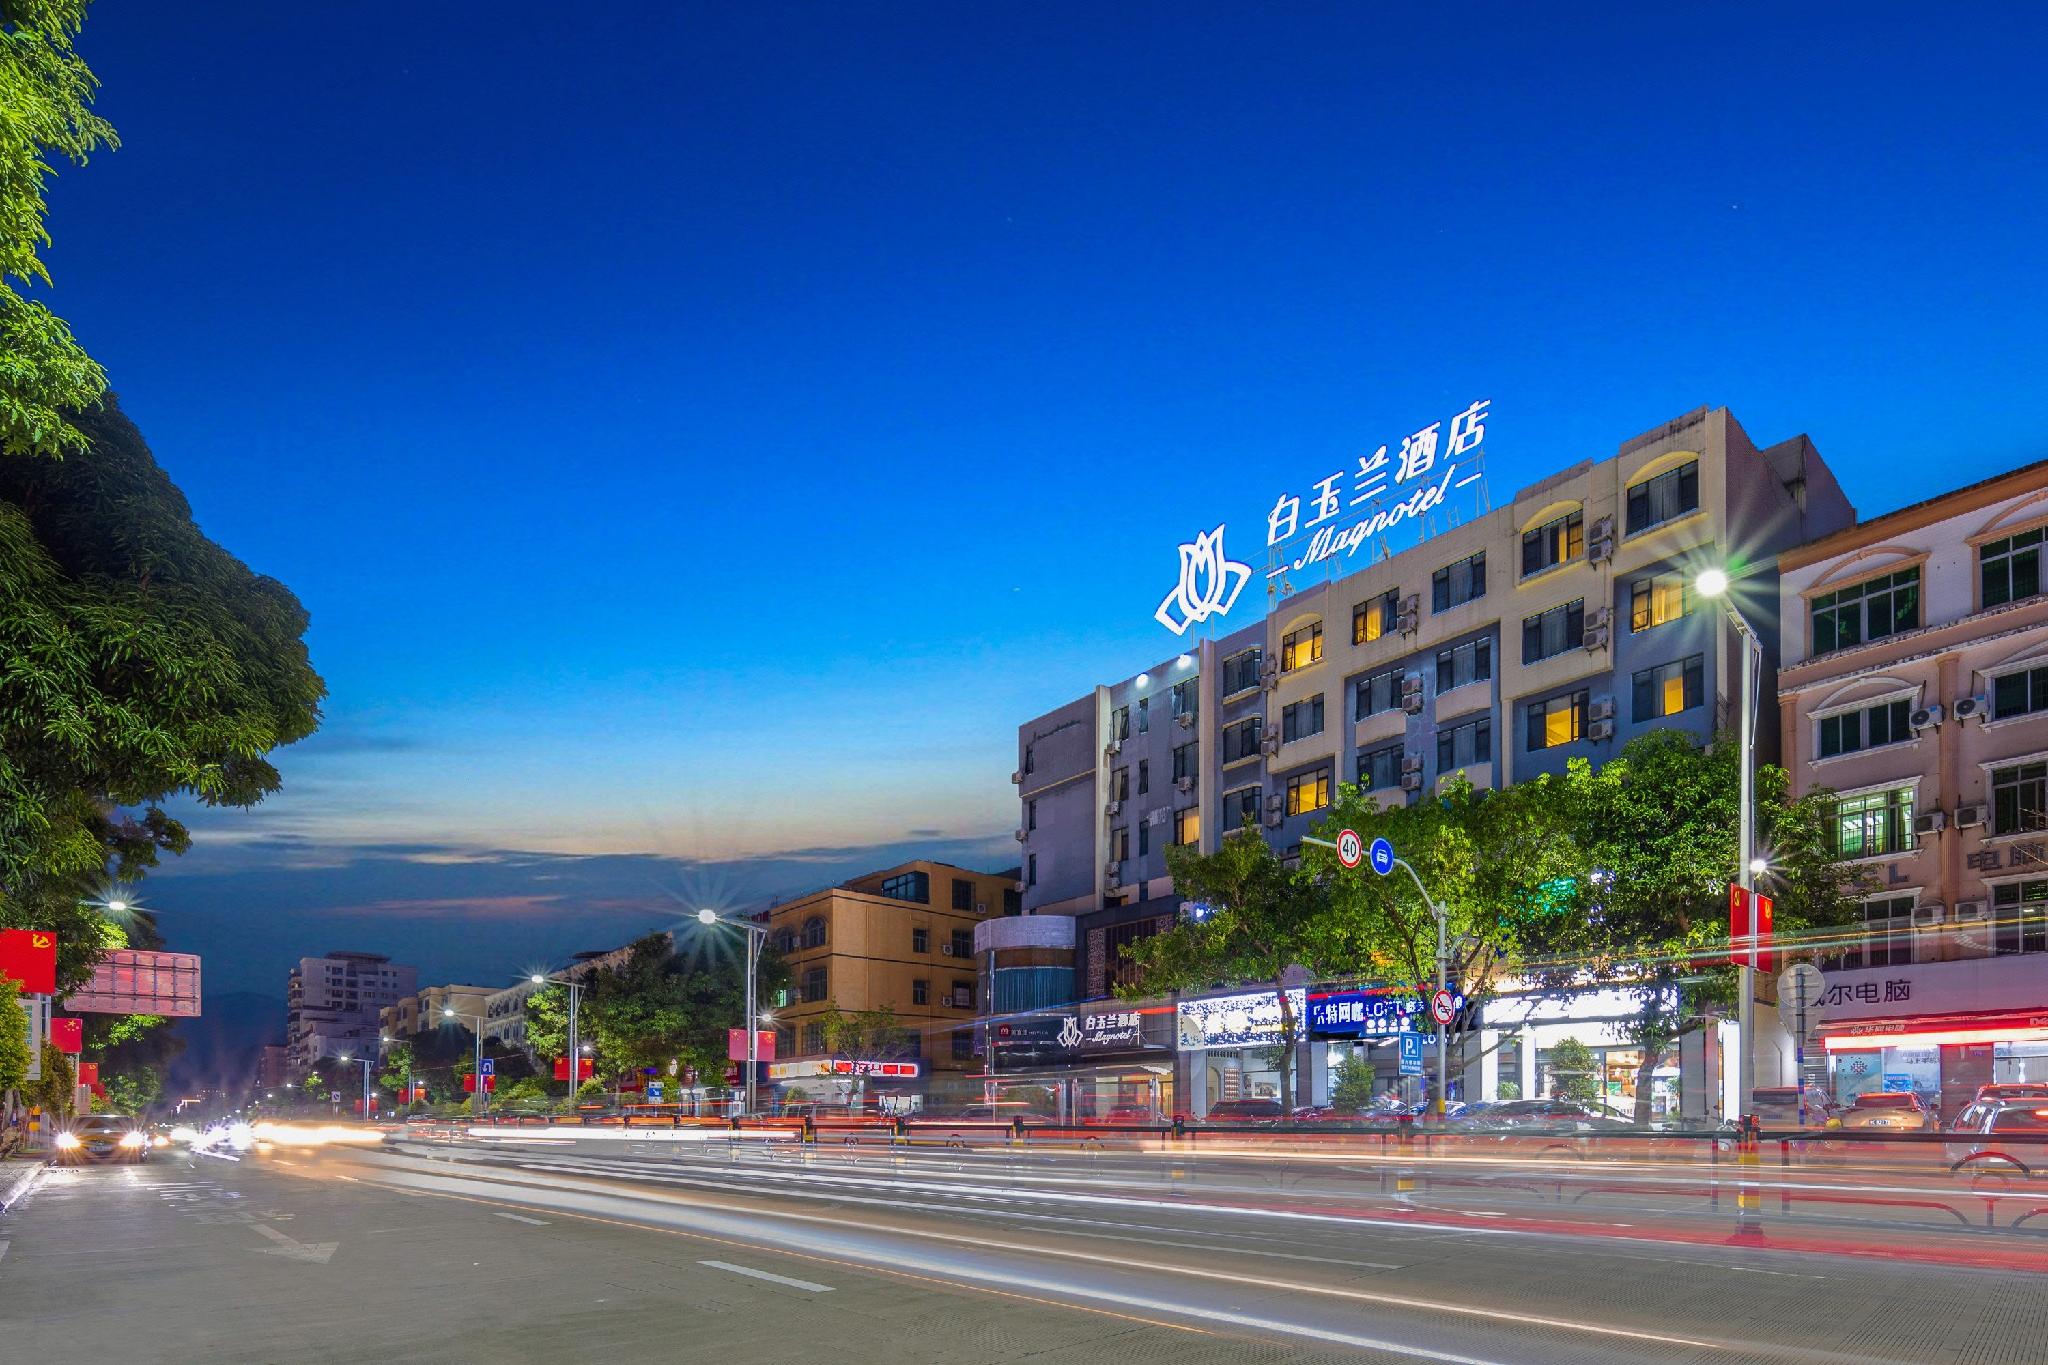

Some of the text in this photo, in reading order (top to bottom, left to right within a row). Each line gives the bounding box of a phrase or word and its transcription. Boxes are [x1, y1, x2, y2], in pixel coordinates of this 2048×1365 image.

[1267, 399, 1491, 546] 白玉兰酒店
[1294, 464, 1456, 570] Magnotel
[1343, 839, 1356, 858] 40
[1810, 979, 1911, 1006] 尔电脑
[1085, 1012, 1140, 1030] 白玉兰酒店
[1405, 1038, 1413, 1055] P
